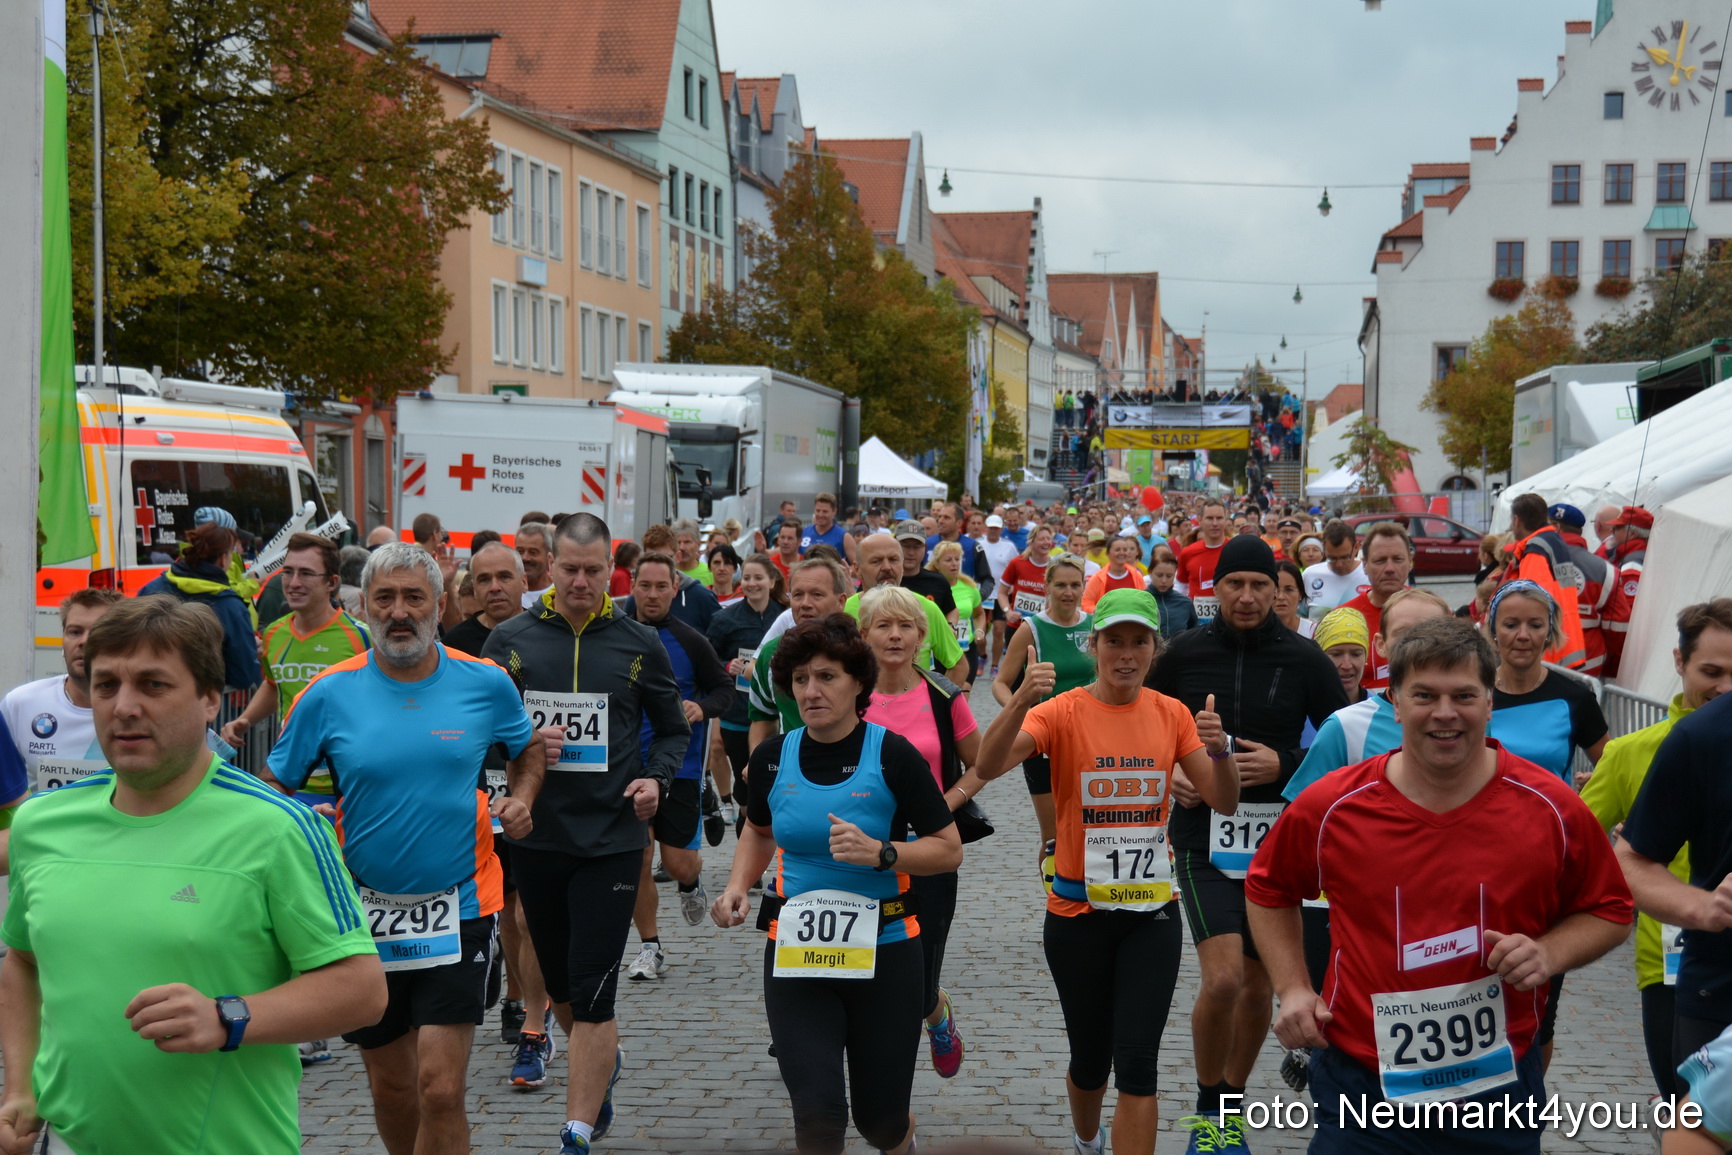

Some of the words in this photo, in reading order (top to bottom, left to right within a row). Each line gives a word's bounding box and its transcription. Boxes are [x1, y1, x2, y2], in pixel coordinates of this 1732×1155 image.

[1151, 433, 1200, 446] START
[493, 454, 561, 468] Bayerisches
[492, 468, 525, 480] Rotes
[491, 484, 525, 494] Kreuz
[863, 484, 909, 495] Laufsport
[154, 488, 189, 507] Bayerisches
[157, 507, 174, 525] Rotes
[158, 529, 176, 544] Kreuz
[1017, 598, 1042, 613] 2604
[526, 698, 551, 708] PARTL
[553, 700, 593, 709] Neumarkt
[532, 710, 601, 742] 2454
[29, 742, 56, 751] PARTL
[40, 764, 69, 775] PARTL
[1095, 756, 1116, 769] 30
[1119, 756, 1155, 768] Jahre
[1088, 778, 1161, 798] OBI
[1082, 807, 1162, 824] Neumarkt
[1243, 810, 1281, 818] Neumarkt
[1087, 837, 1118, 845] PARTL
[1106, 848, 1156, 880] 172
[170, 894, 200, 904] adidas
[1110, 888, 1154, 902] Sylvana
[816, 897, 862, 909] Neumarkt
[368, 899, 450, 938] 2292
[797, 909, 859, 943] 307
[391, 943, 430, 958] Martin
[1423, 939, 1457, 958] DEHN
[803, 951, 846, 968] Margit
[1376, 1004, 1418, 1016] PARTL
[1421, 991, 1483, 1013] Neumarkt
[1389, 1005, 1497, 1066] 2399
[1385, 1063, 1391, 1071] A
[1421, 1066, 1479, 1087] Günter
